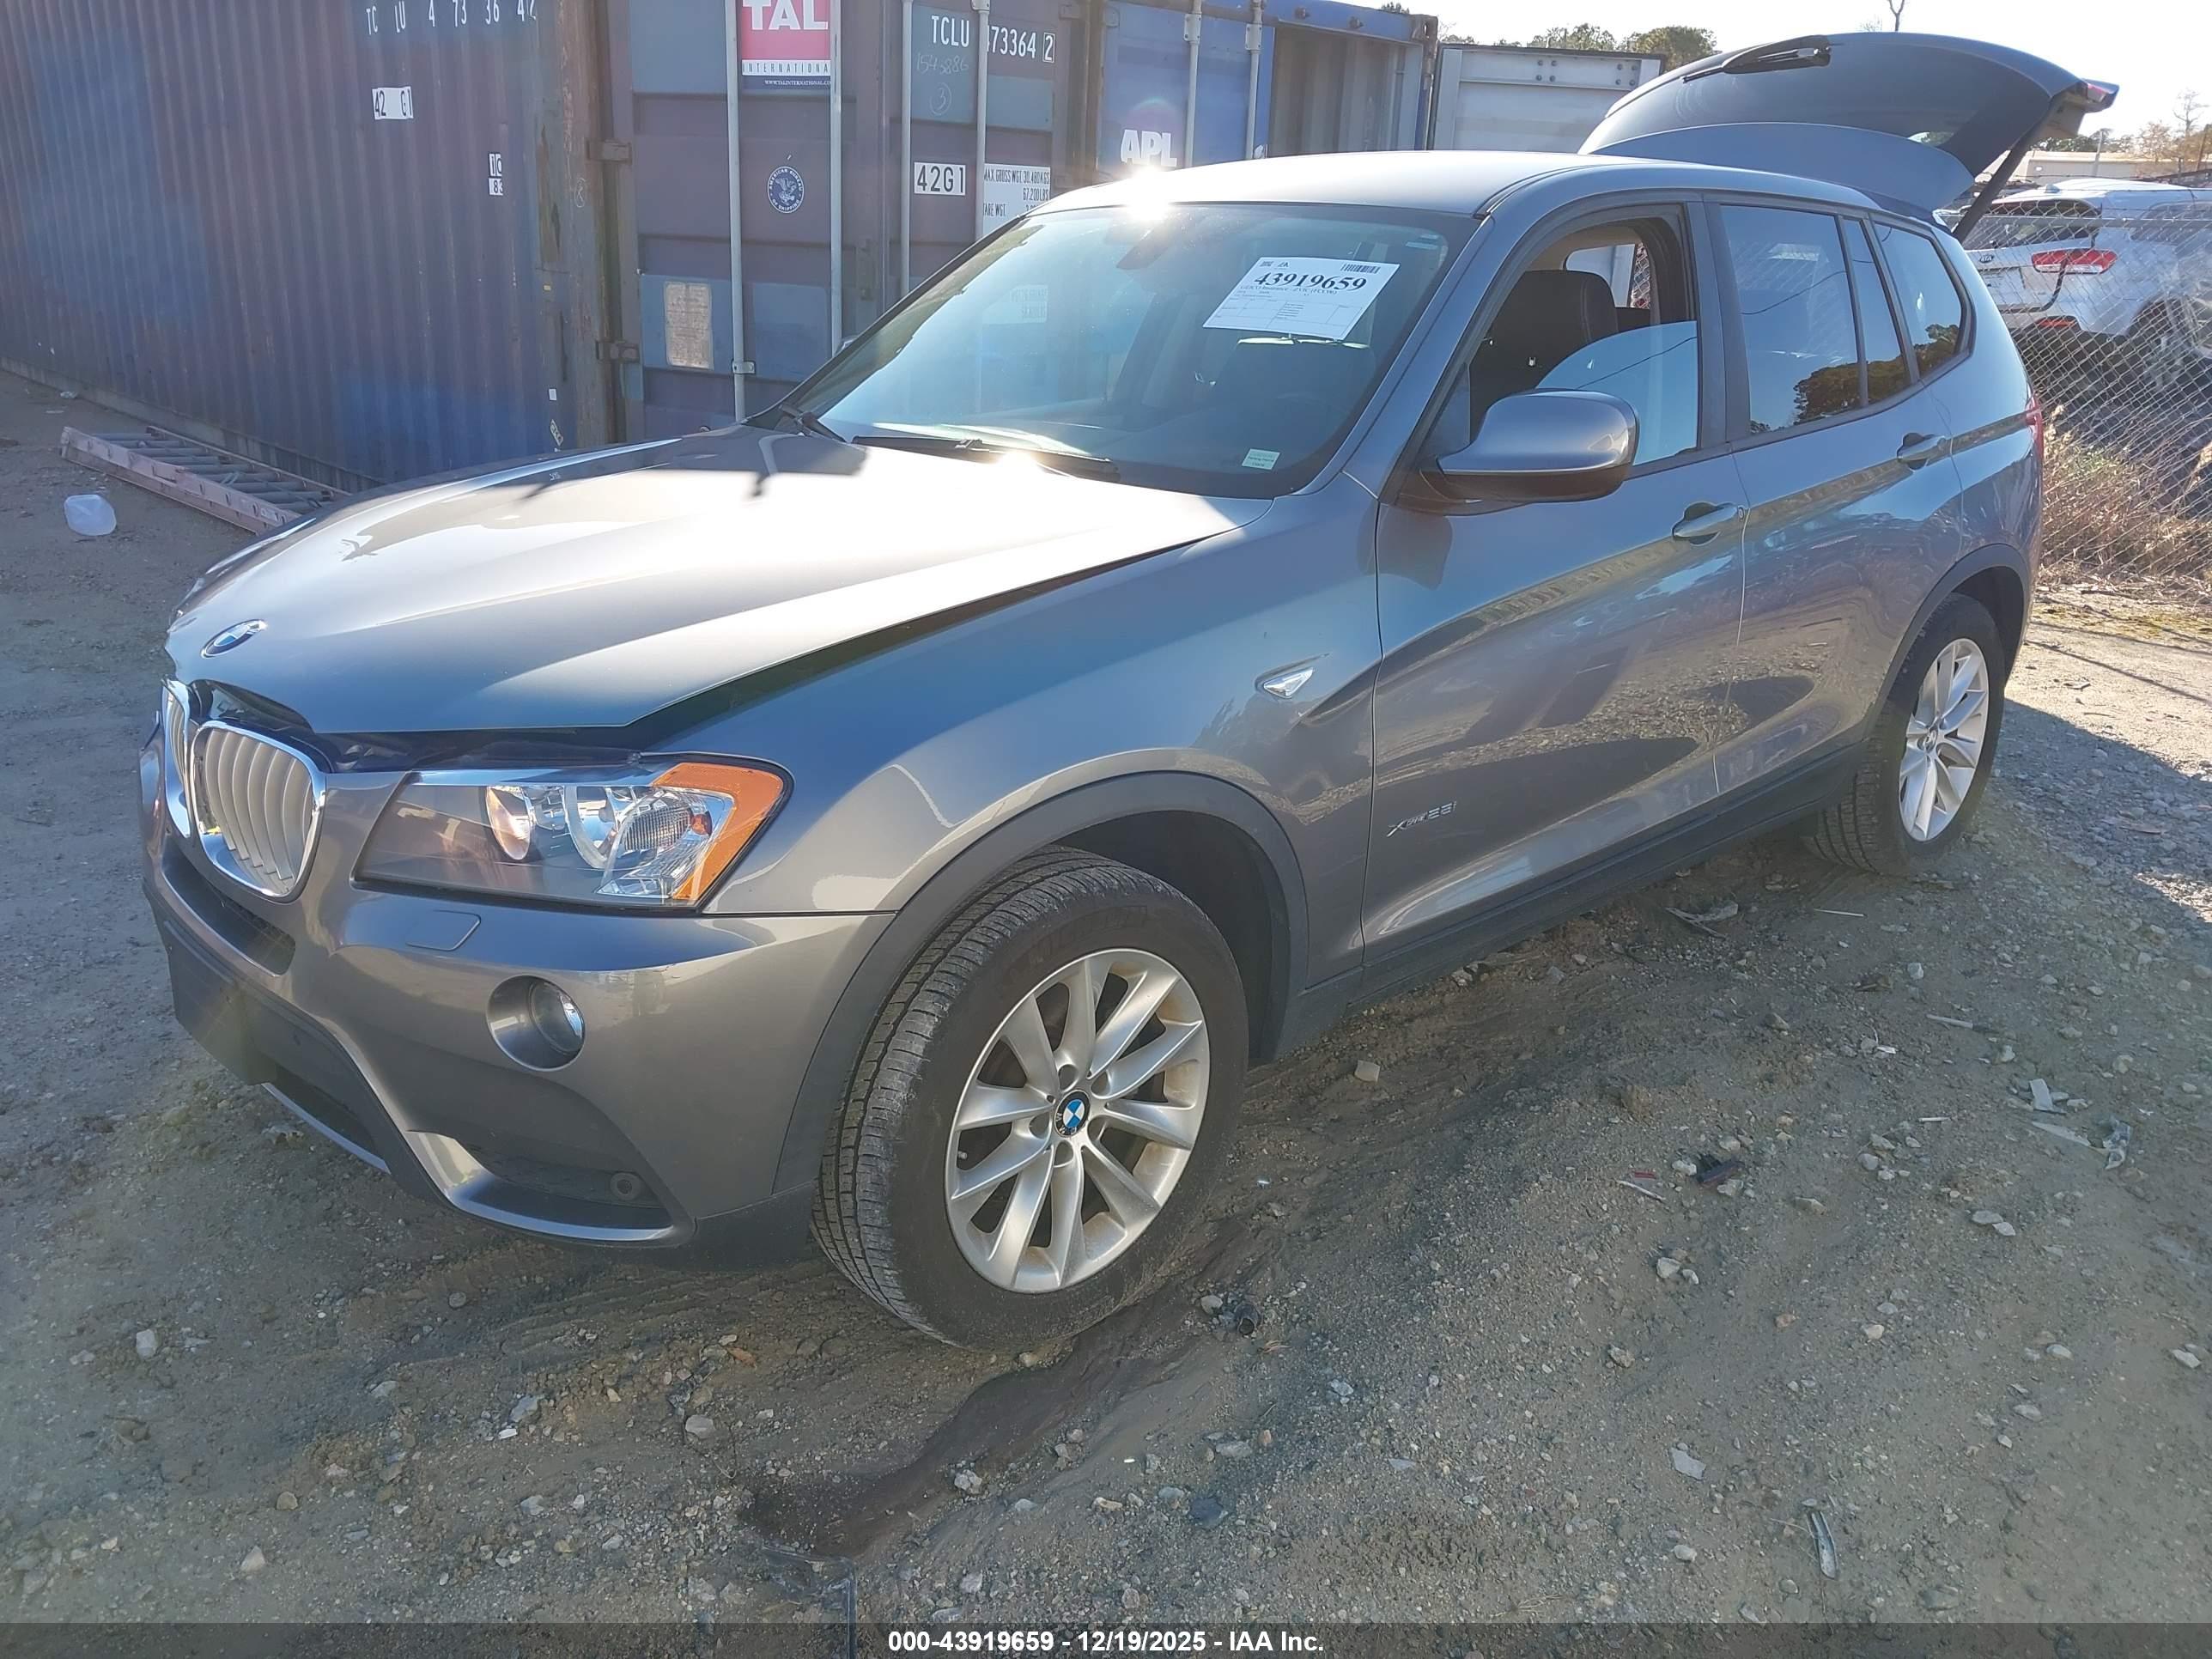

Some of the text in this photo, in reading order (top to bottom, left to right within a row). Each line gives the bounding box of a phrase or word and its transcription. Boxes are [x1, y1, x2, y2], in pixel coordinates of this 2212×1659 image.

[743, 0, 829, 30] TAL
[932, 15, 969, 47] TCLU
[1044, 35, 1054, 62] 2
[742, 63, 830, 73] INTERNATIONA
[1121, 129, 1177, 167] APL
[917, 164, 963, 193] 42G1
[1254, 272, 1368, 292] 43919659
